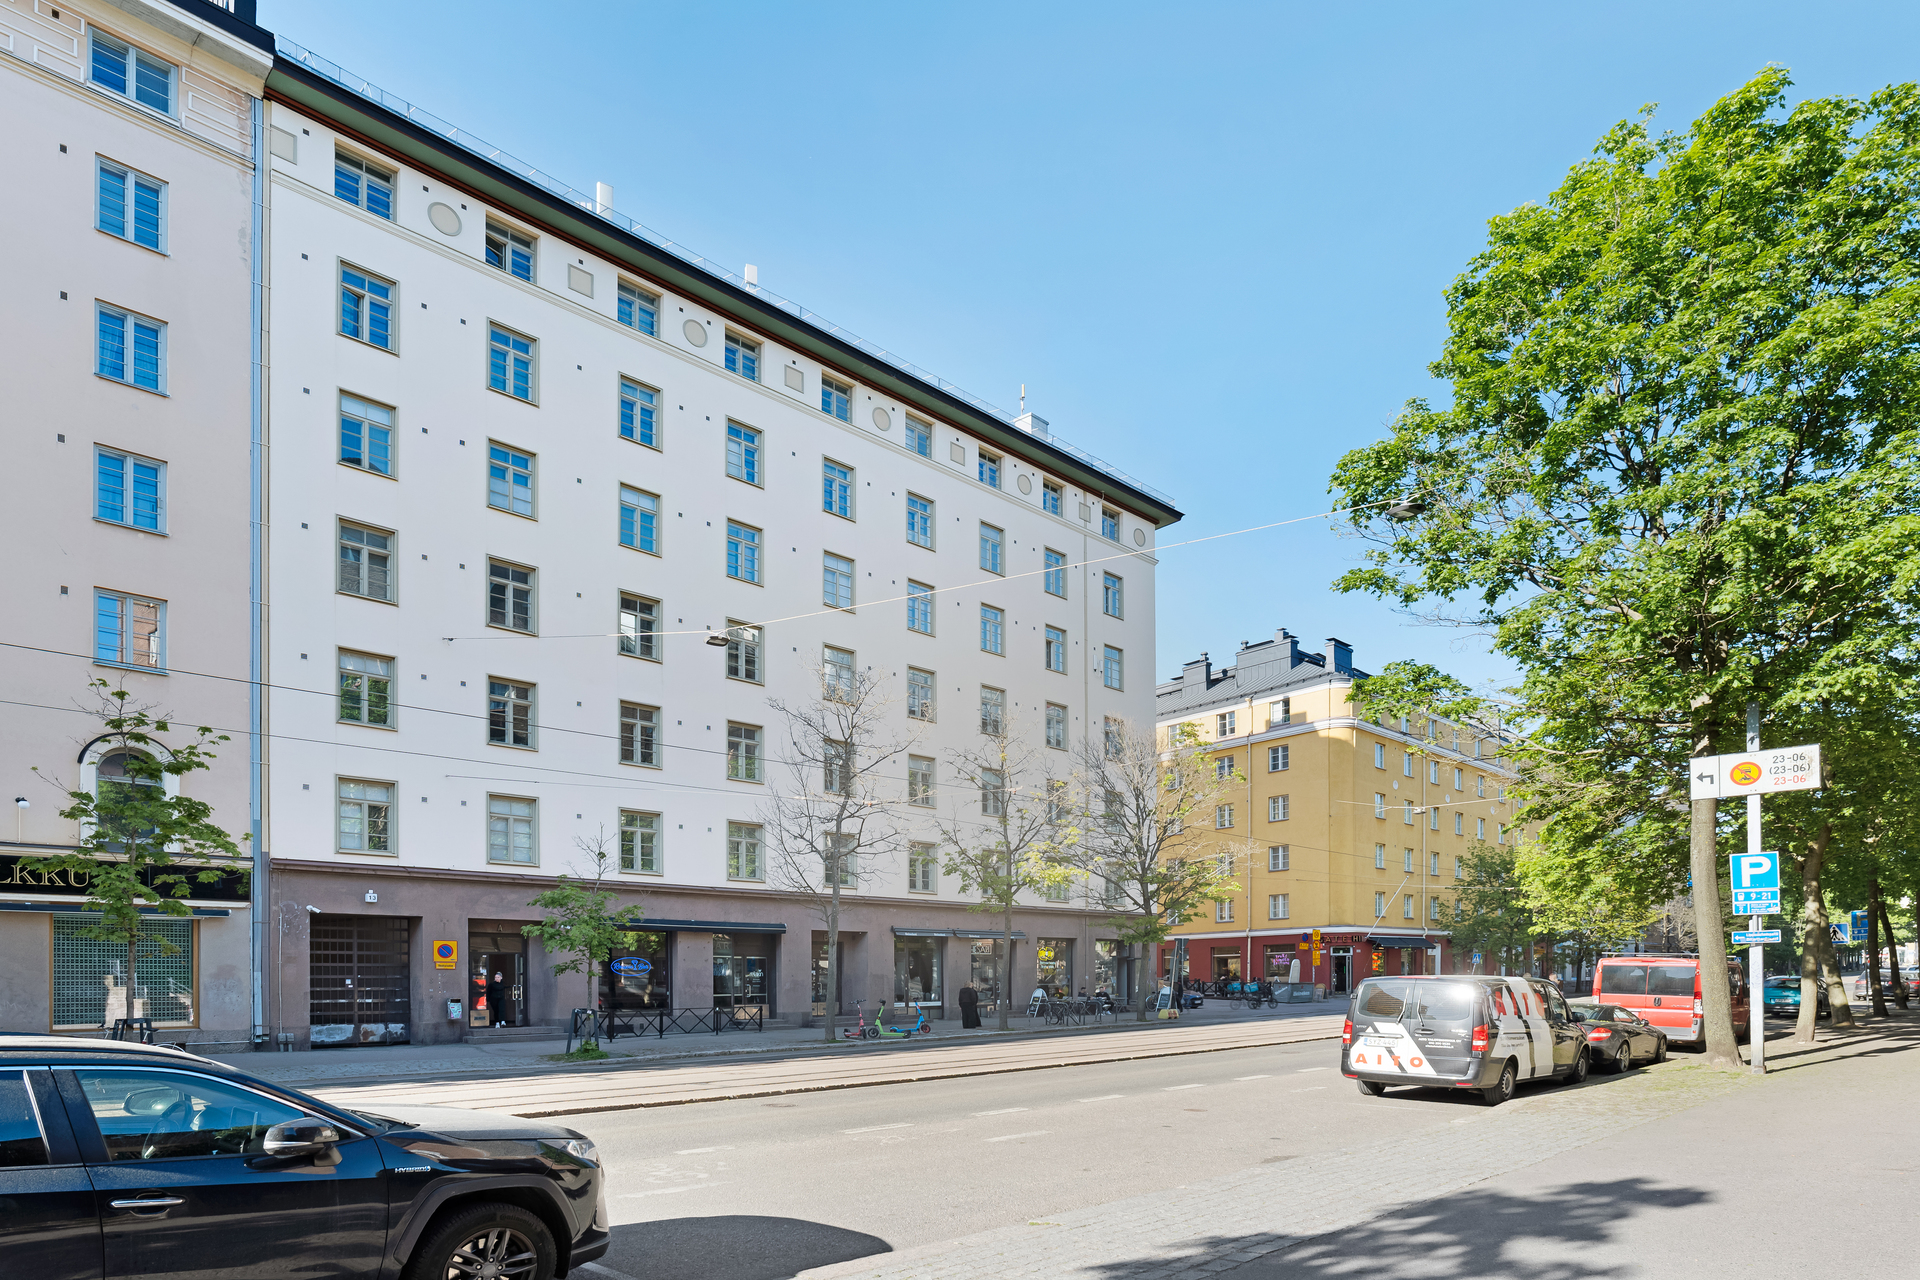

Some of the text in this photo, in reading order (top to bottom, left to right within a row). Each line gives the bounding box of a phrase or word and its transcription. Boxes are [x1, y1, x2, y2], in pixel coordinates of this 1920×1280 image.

[1772, 753, 1806, 764] 23-06
[1769, 763, 1811, 775] (23-06)
[1773, 775, 1807, 786] 23-06
[1741, 856, 1772, 887] P
[1495, 991, 1545, 1016] AITO
[1368, 1038, 1396, 1046] SYZ-445
[1355, 1053, 1424, 1068] AITO
